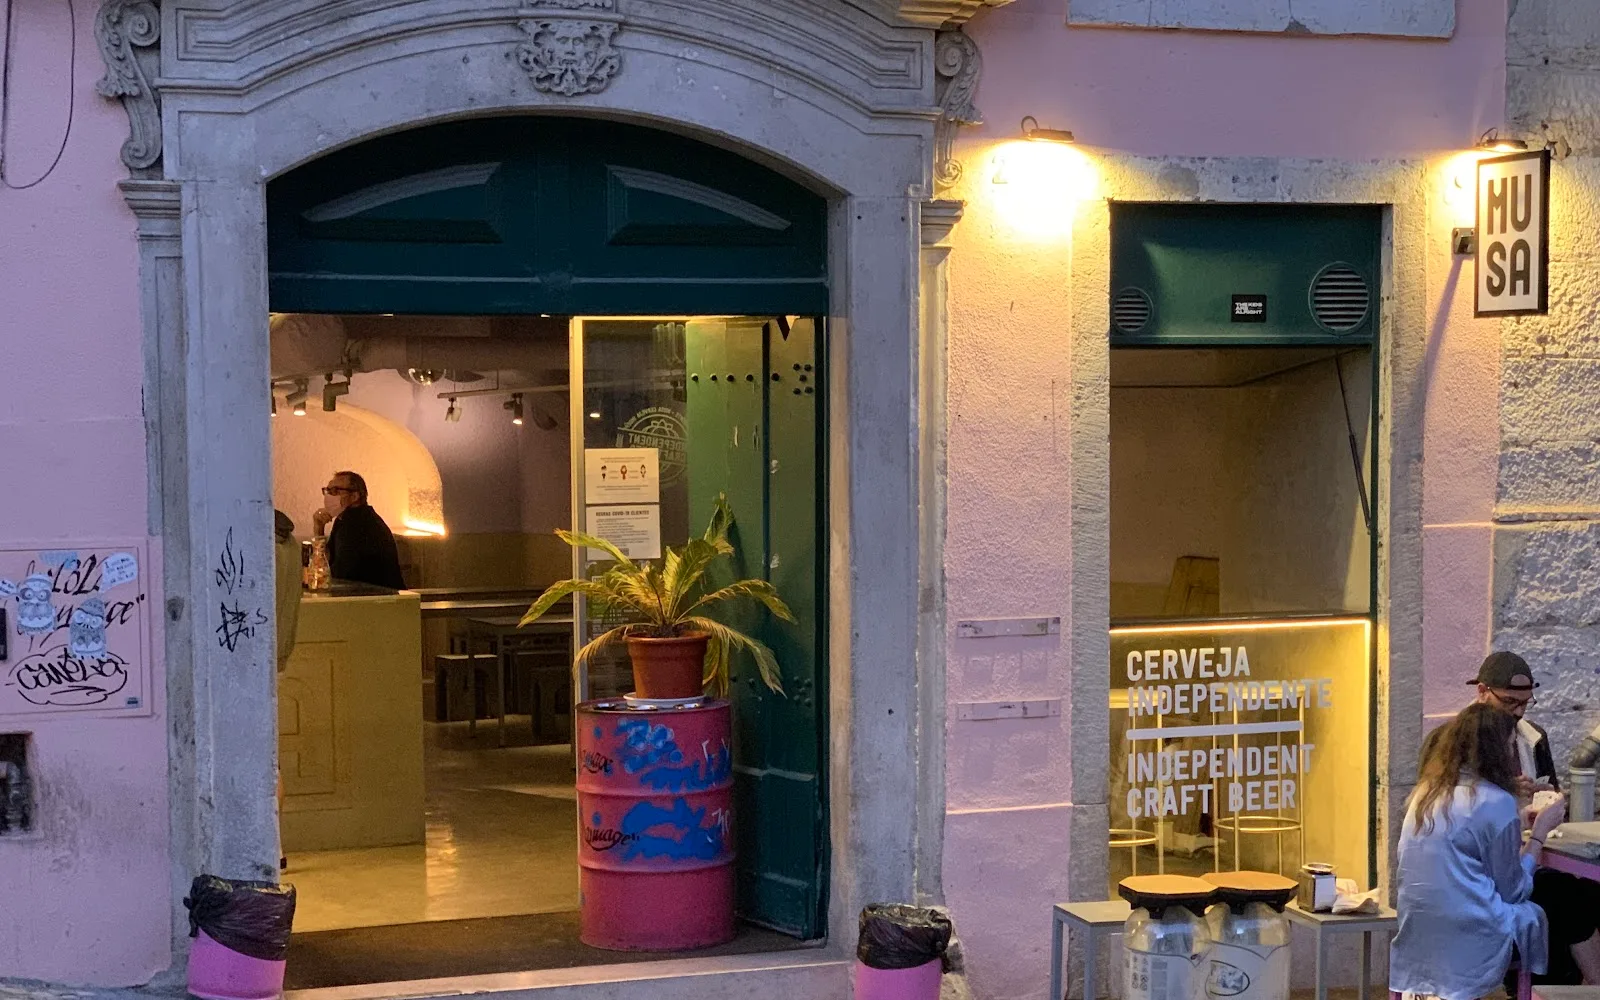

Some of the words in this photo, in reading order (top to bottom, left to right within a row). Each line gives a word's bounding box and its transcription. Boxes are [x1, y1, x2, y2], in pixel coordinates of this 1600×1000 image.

[1487, 174, 1532, 235] MU
[1486, 238, 1531, 297] SA
[1126, 646, 1251, 682] CERVEJA
[1127, 677, 1334, 717] INDEPENDENTE
[1127, 743, 1315, 784] INDEPENDENT
[1126, 783, 1214, 818] CRAFT
[1228, 779, 1297, 812] BEER
